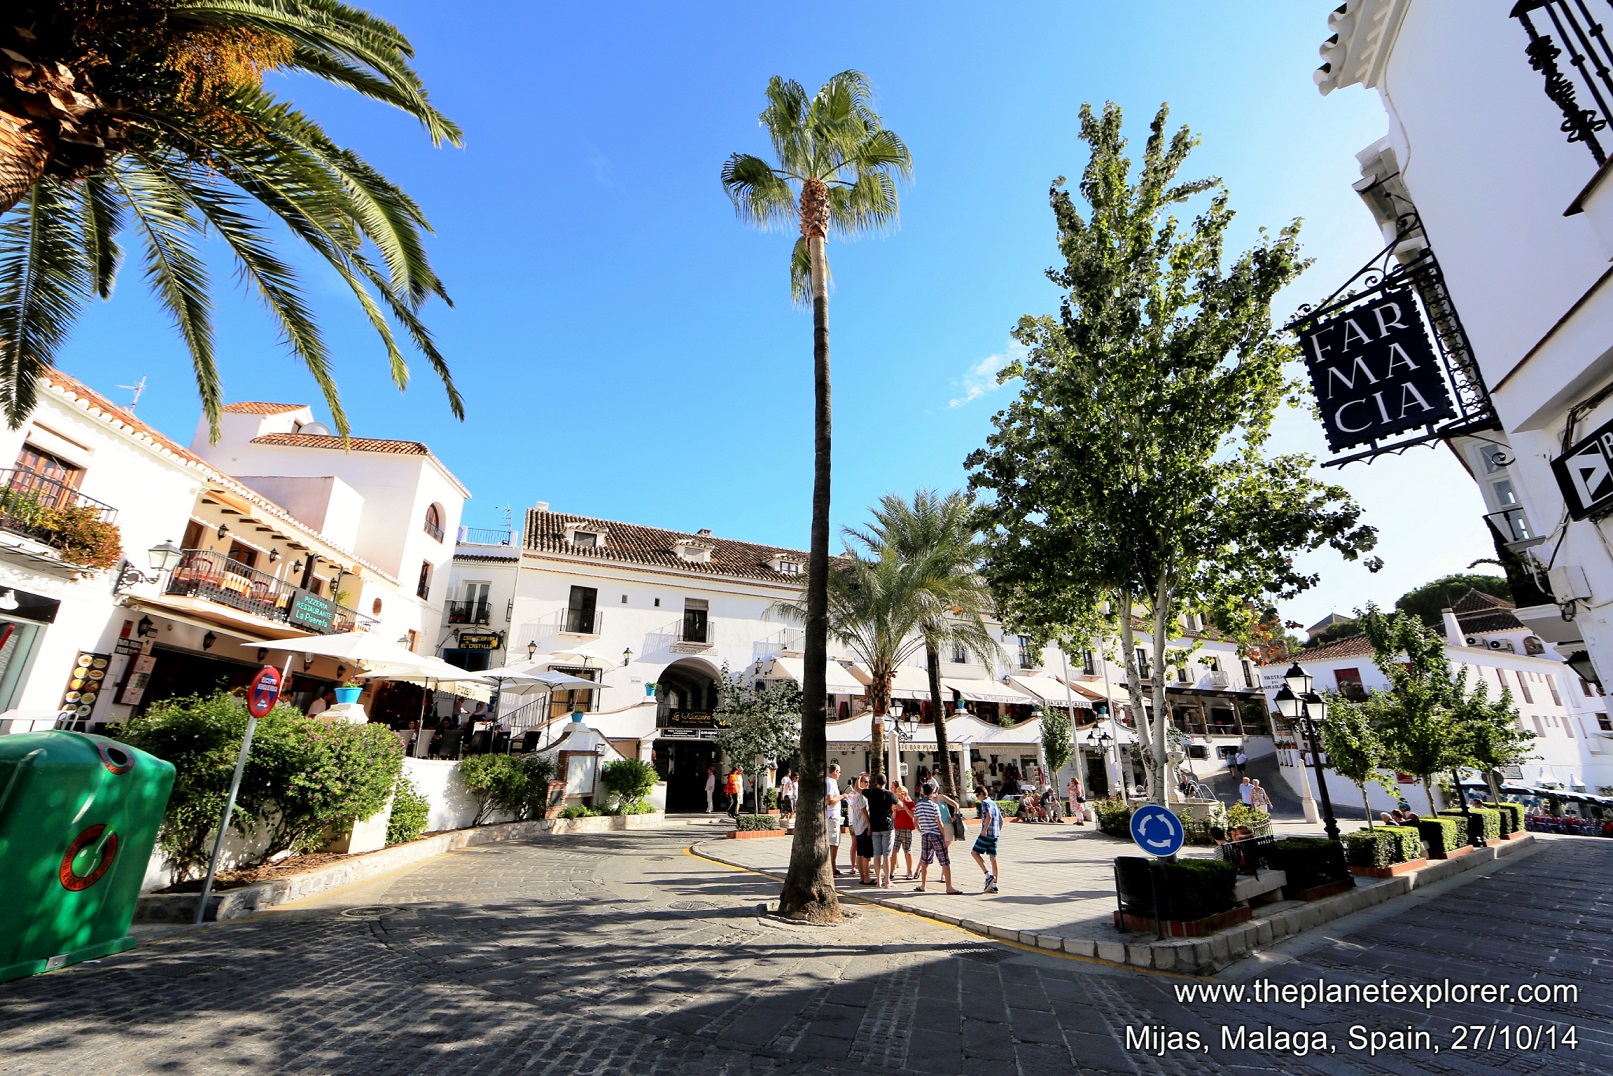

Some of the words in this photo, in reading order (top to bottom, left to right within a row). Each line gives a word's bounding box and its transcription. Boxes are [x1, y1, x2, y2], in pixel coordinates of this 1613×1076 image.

[1309, 301, 1409, 364] FAR
[1326, 342, 1420, 399] MA
[1334, 381, 1435, 433] CIA
[296, 601, 333, 619] RESTAURANTE
[304, 595, 328, 610] PIZZERIA
